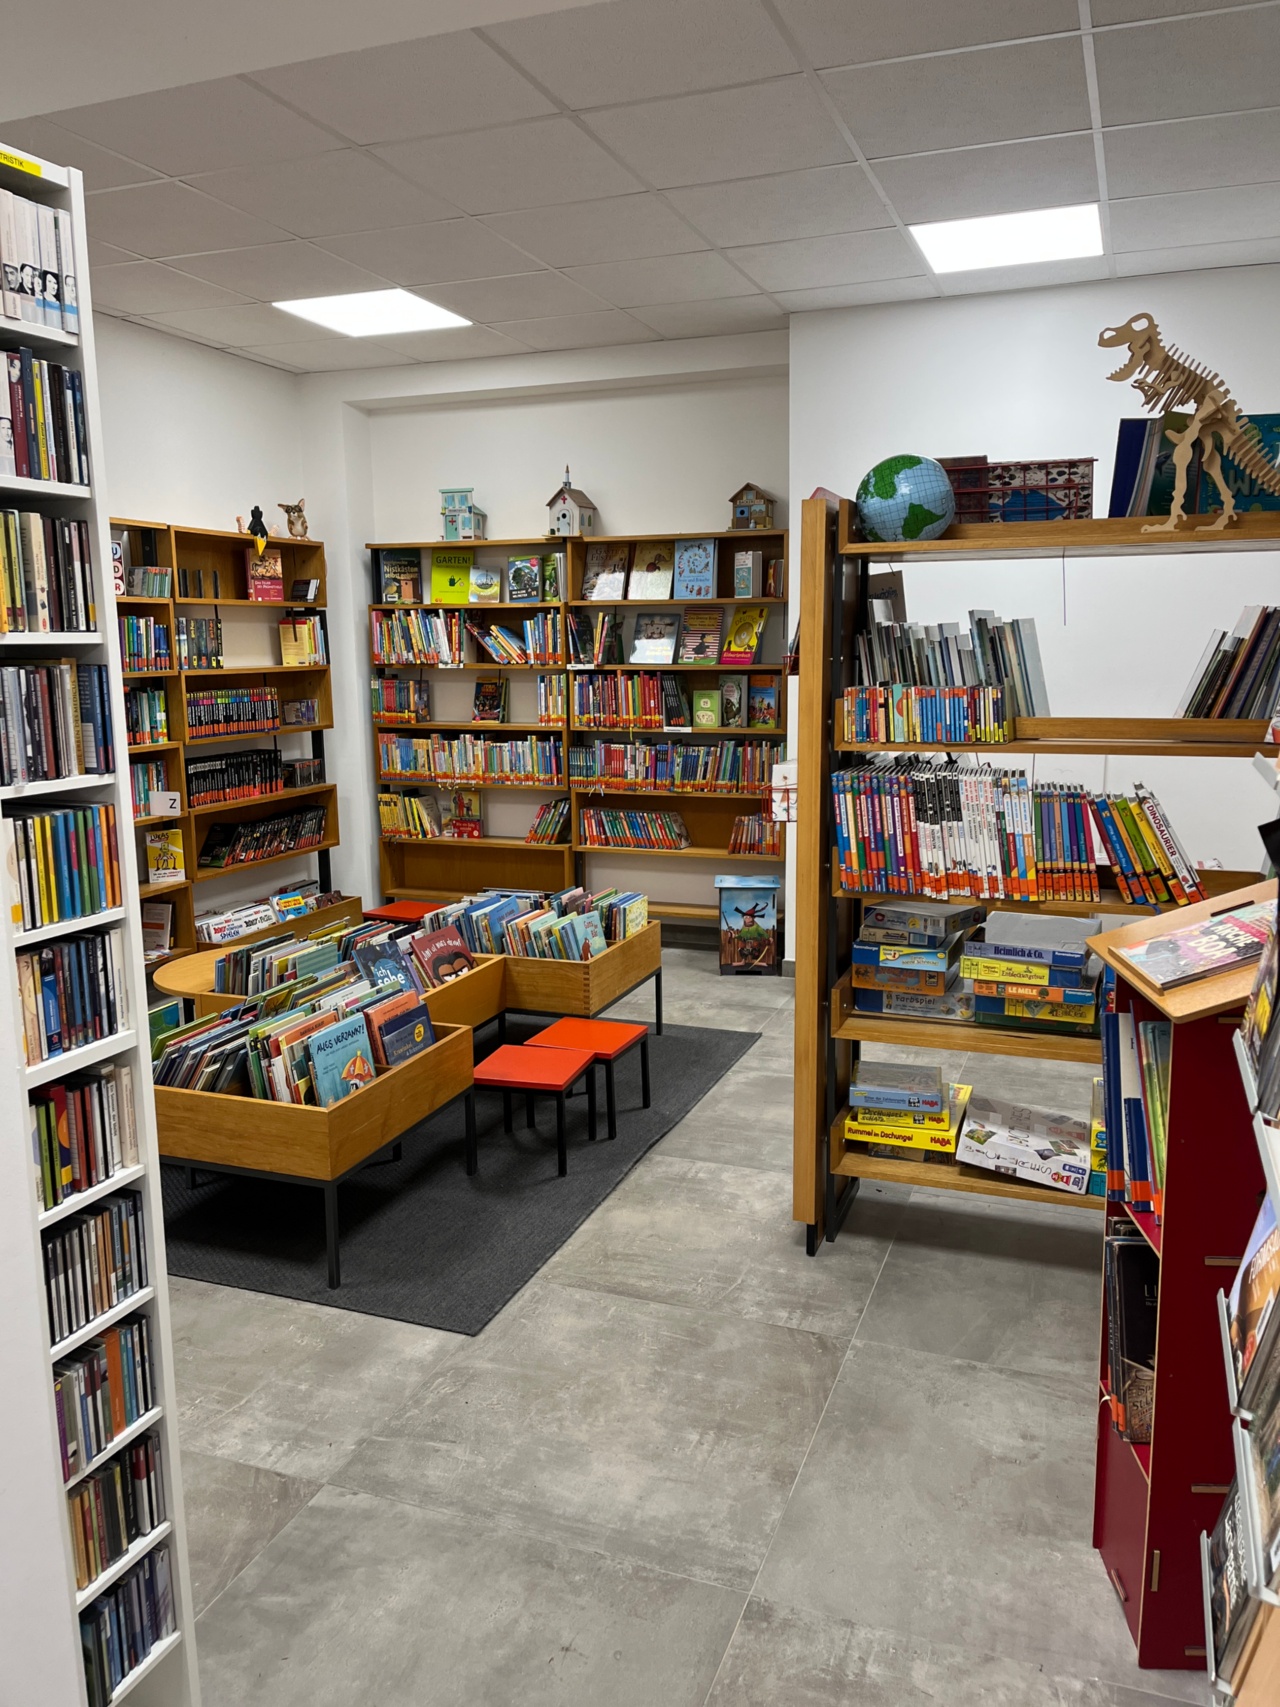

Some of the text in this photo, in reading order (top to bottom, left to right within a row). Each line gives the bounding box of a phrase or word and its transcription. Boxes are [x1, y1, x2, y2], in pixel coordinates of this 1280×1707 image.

[436, 555, 470, 564] GARTEN!
[71, 680, 80, 713] MEDICUS
[169, 798, 177, 809] Z
[1146, 803, 1177, 858] DINOSAURIER
[994, 946, 1044, 959] Heimlich & Co.
[1017, 987, 1037, 996] MELE
[895, 995, 936, 1005] Farbspiel
[848, 1127, 874, 1136] Rummel
[880, 1131, 913, 1142] Dschungel
[930, 1136, 952, 1147] HABA
